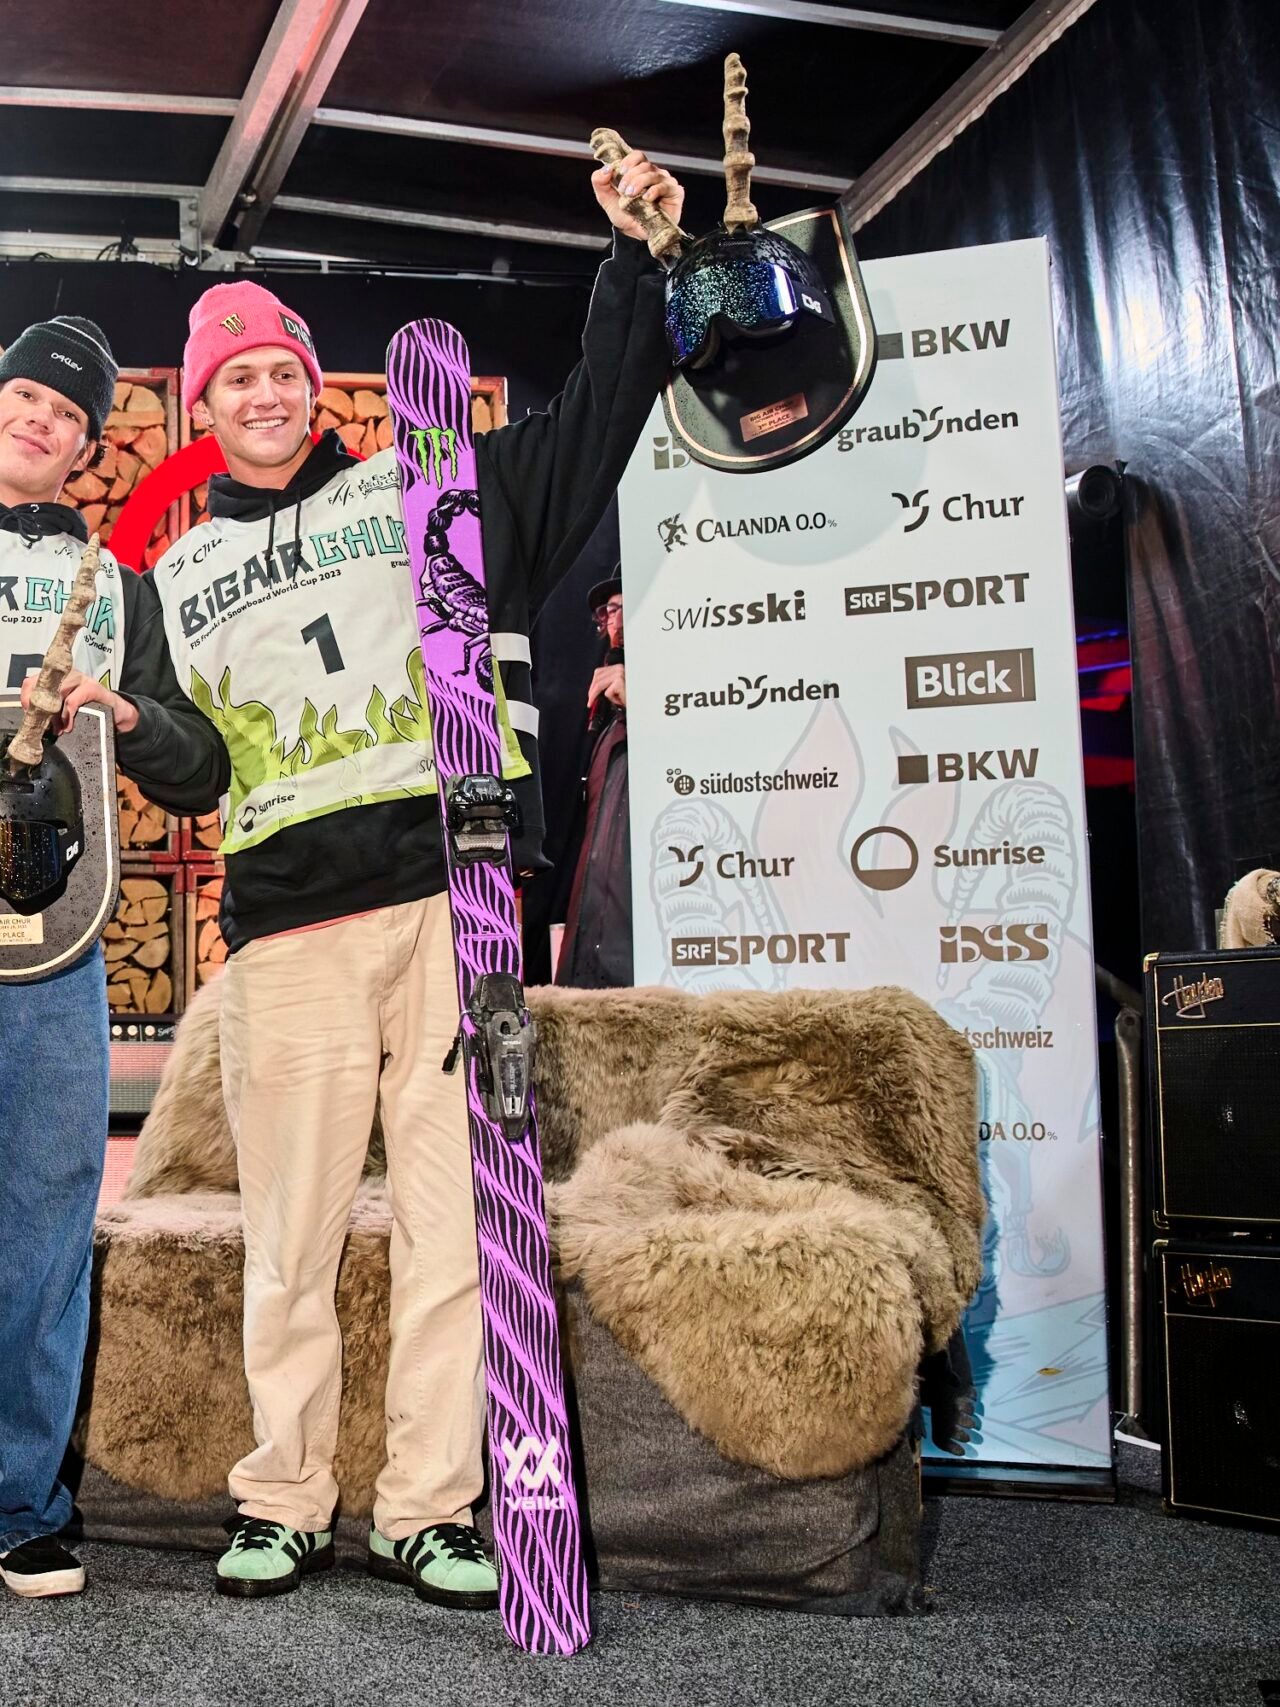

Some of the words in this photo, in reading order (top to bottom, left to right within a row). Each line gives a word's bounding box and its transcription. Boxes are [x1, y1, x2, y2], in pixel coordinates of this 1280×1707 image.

[911, 318, 1011, 358] BKW
[942, 493, 1024, 522] Chur
[696, 515, 791, 543] CALANDA
[24, 576, 116, 640] CHR
[190, 638, 201, 650] FIS
[227, 593, 272, 619] Snowboard
[272, 581, 299, 598] World
[300, 577, 318, 588] Cup
[319, 568, 342, 581] 2023
[849, 591, 886, 610] SRF
[891, 572, 1030, 613] SPORT
[1, 616, 19, 625] Cup
[21, 615, 43, 624] 2023
[300, 612, 345, 675] 1
[916, 660, 1012, 699] Blick
[700, 767, 838, 795] südostschweiz
[937, 748, 1039, 783] BKW
[716, 851, 795, 879] Chur
[934, 841, 1045, 867] Sunrise
[676, 943, 712, 960] SRF
[717, 932, 851, 966] SPORT
